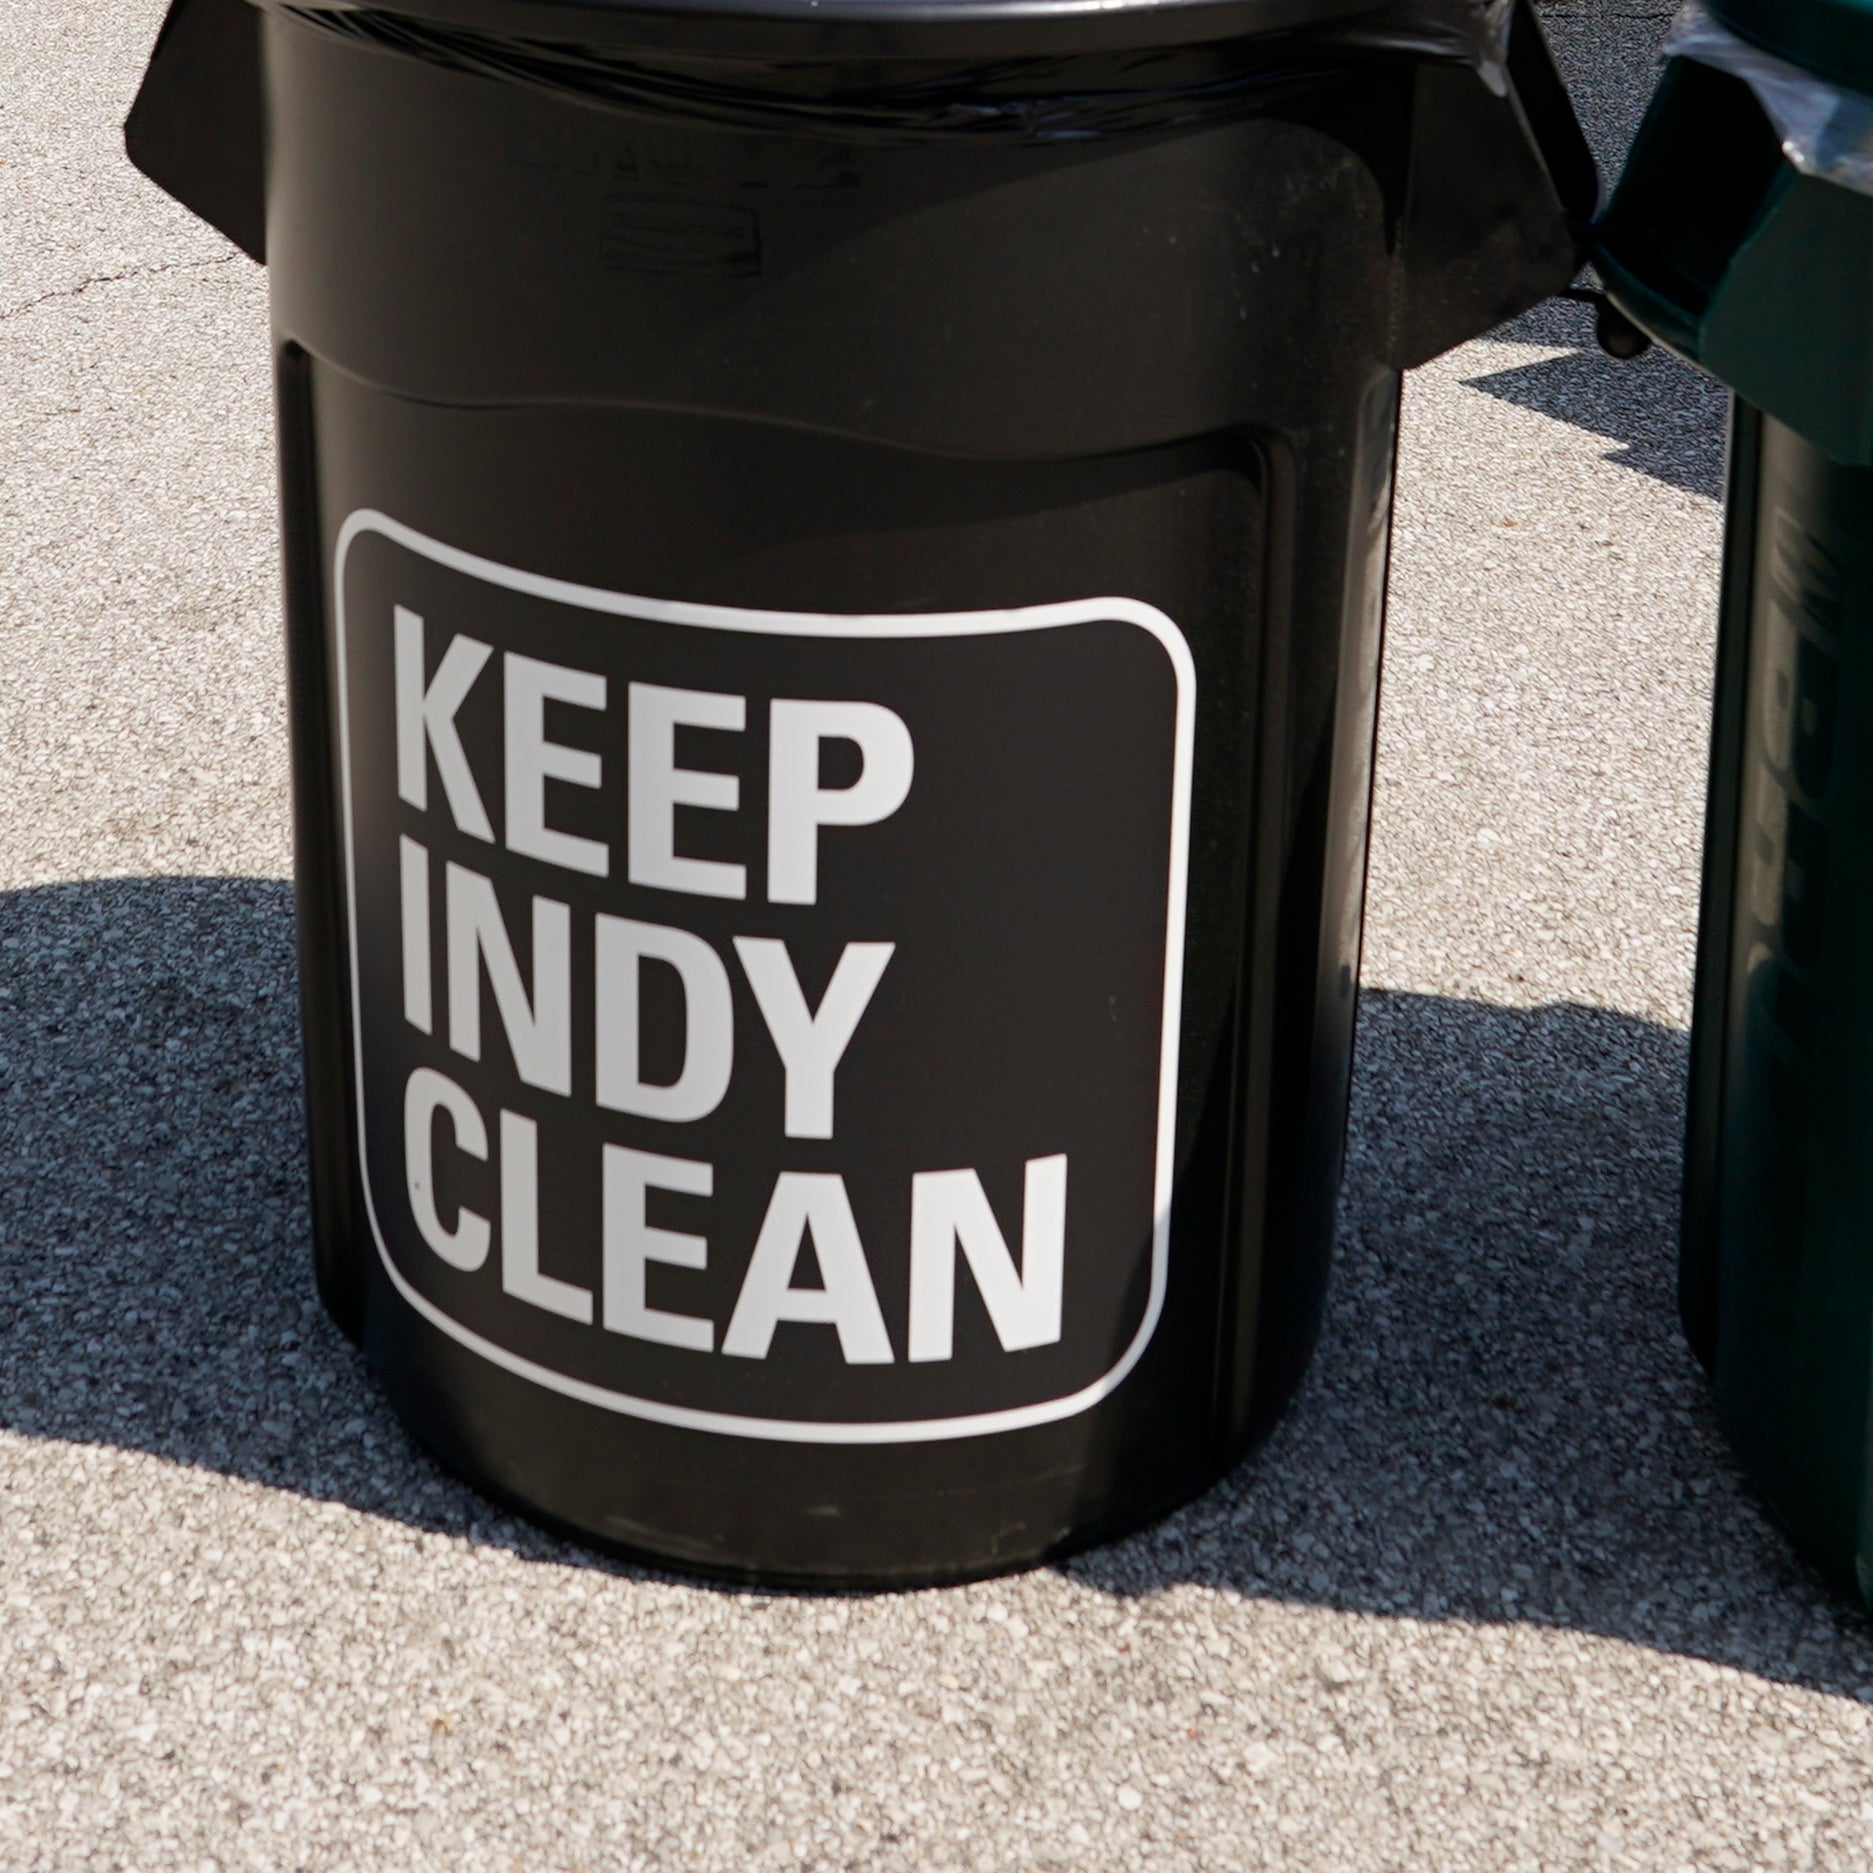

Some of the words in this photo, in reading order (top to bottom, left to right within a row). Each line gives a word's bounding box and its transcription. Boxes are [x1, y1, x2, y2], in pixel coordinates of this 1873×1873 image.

[393, 603, 916, 906] KEEP
[399, 832, 897, 1141] INDY
[403, 1065, 1068, 1366] CLEAN
